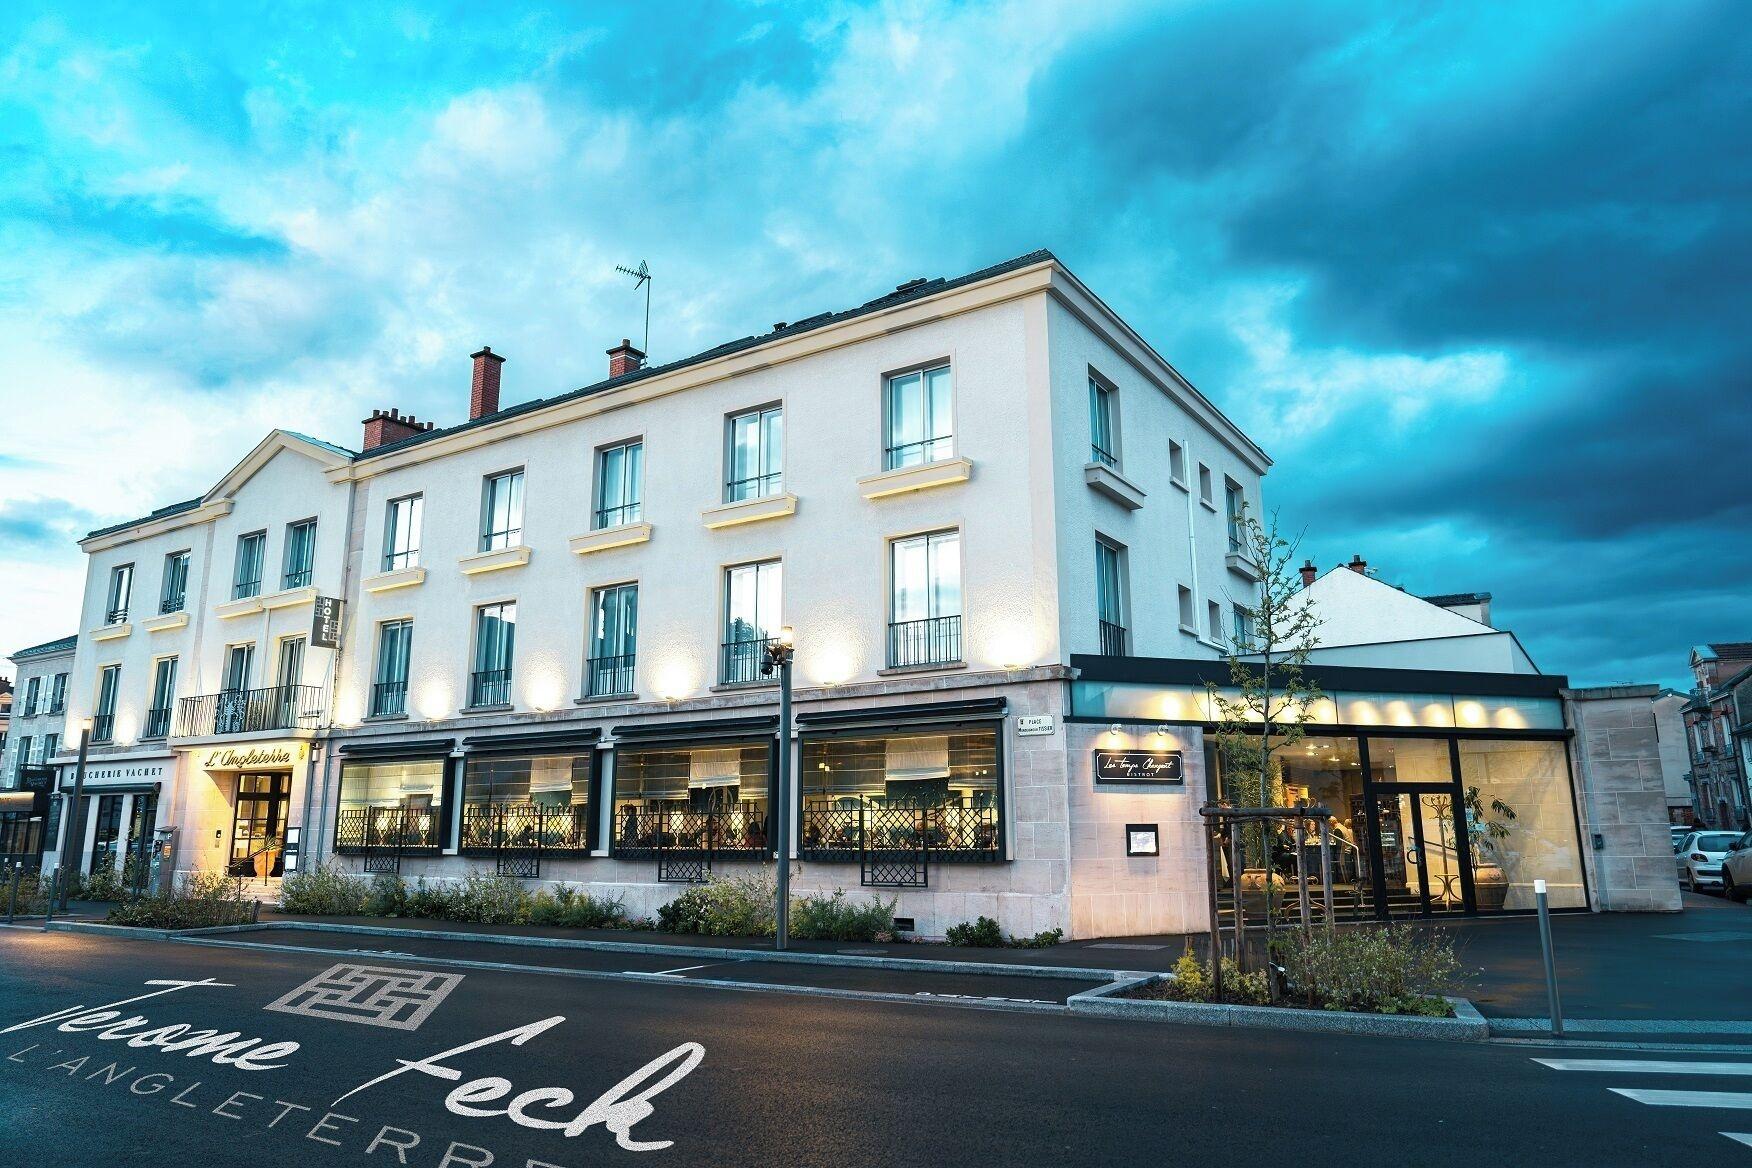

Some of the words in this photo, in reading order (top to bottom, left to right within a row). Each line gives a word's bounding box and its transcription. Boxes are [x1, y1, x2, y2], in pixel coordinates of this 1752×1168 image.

[321, 598, 332, 641] HOTEL
[70, 769, 121, 780] BUCHERIE
[125, 767, 163, 777] VACHET
